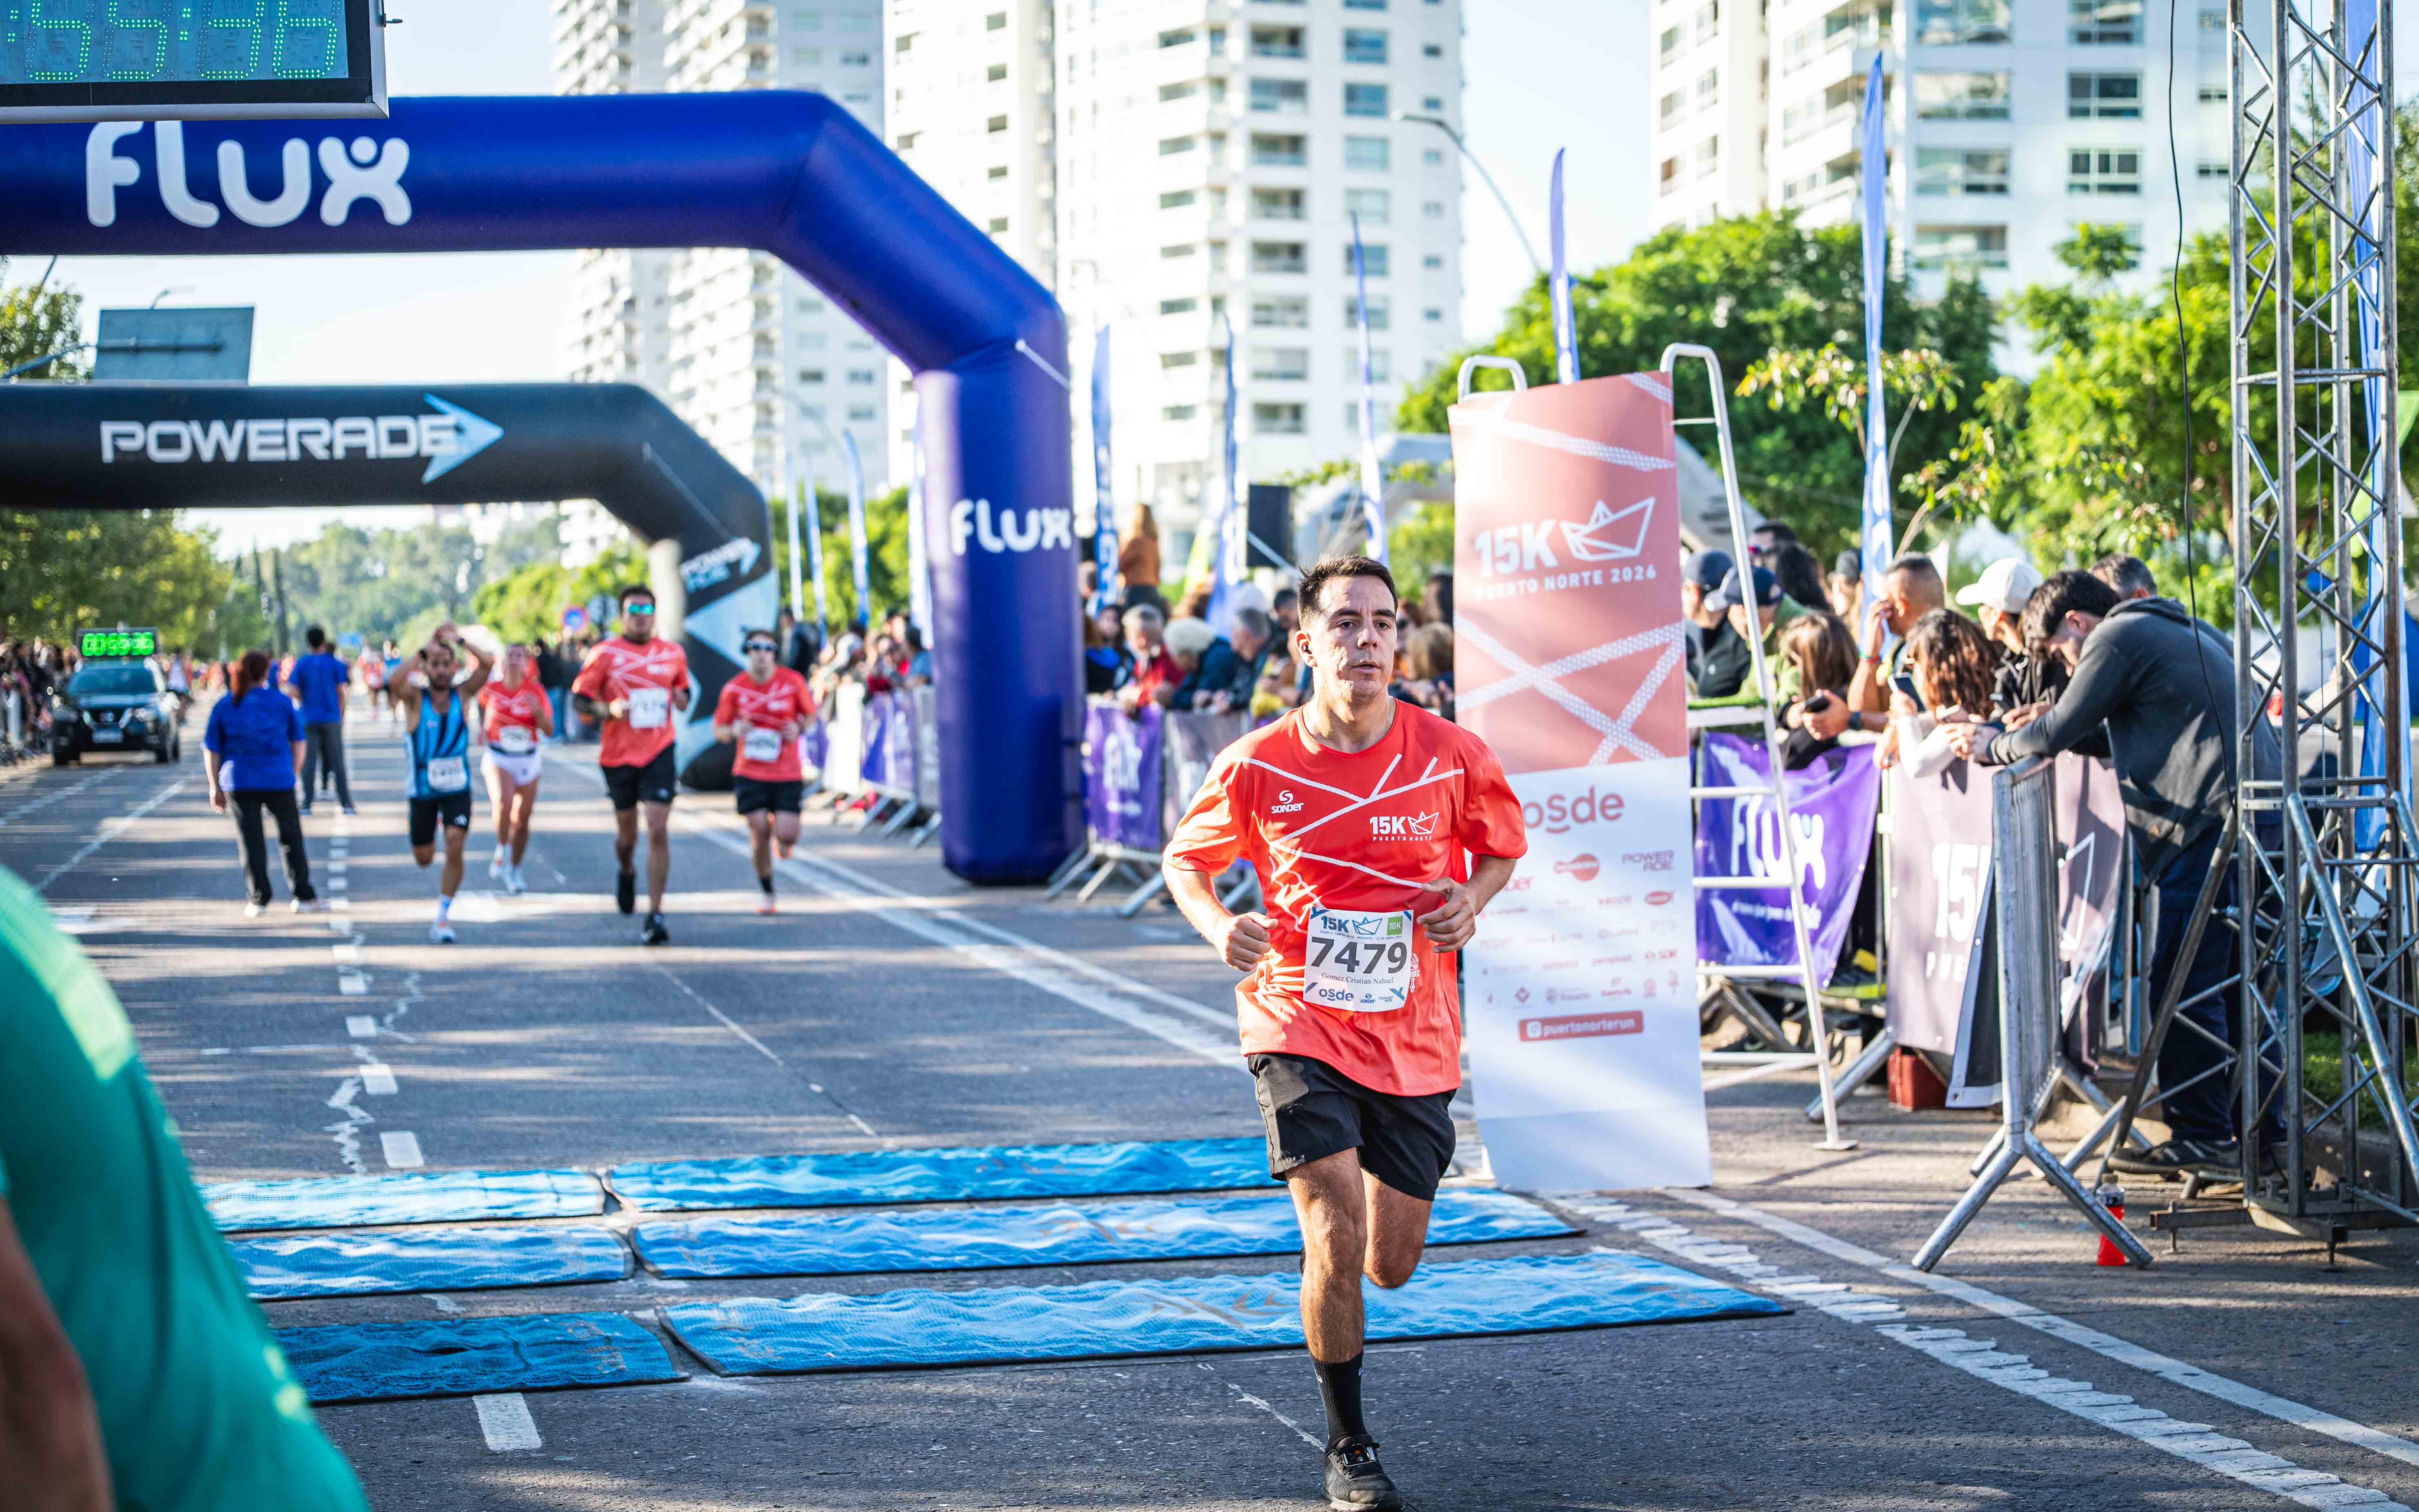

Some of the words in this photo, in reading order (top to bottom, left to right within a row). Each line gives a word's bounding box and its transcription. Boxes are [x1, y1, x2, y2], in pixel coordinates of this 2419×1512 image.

[100, 414, 465, 464] POWERADE
[1475, 519, 1559, 578] 15K
[1475, 578, 1538, 602] PUERTO
[1544, 569, 1604, 591] NORTE
[1610, 563, 1657, 583] 2026
[1369, 816, 1406, 834] 15K
[1523, 784, 1626, 834] osde
[1321, 915, 1350, 933] 15K
[1389, 921, 1401, 930] 10K
[1311, 936, 1408, 974] 7479
[1319, 988, 1354, 1001] osde
[1322, 972, 1345, 982] Gomez
[1346, 976, 1371, 985] Cristian
